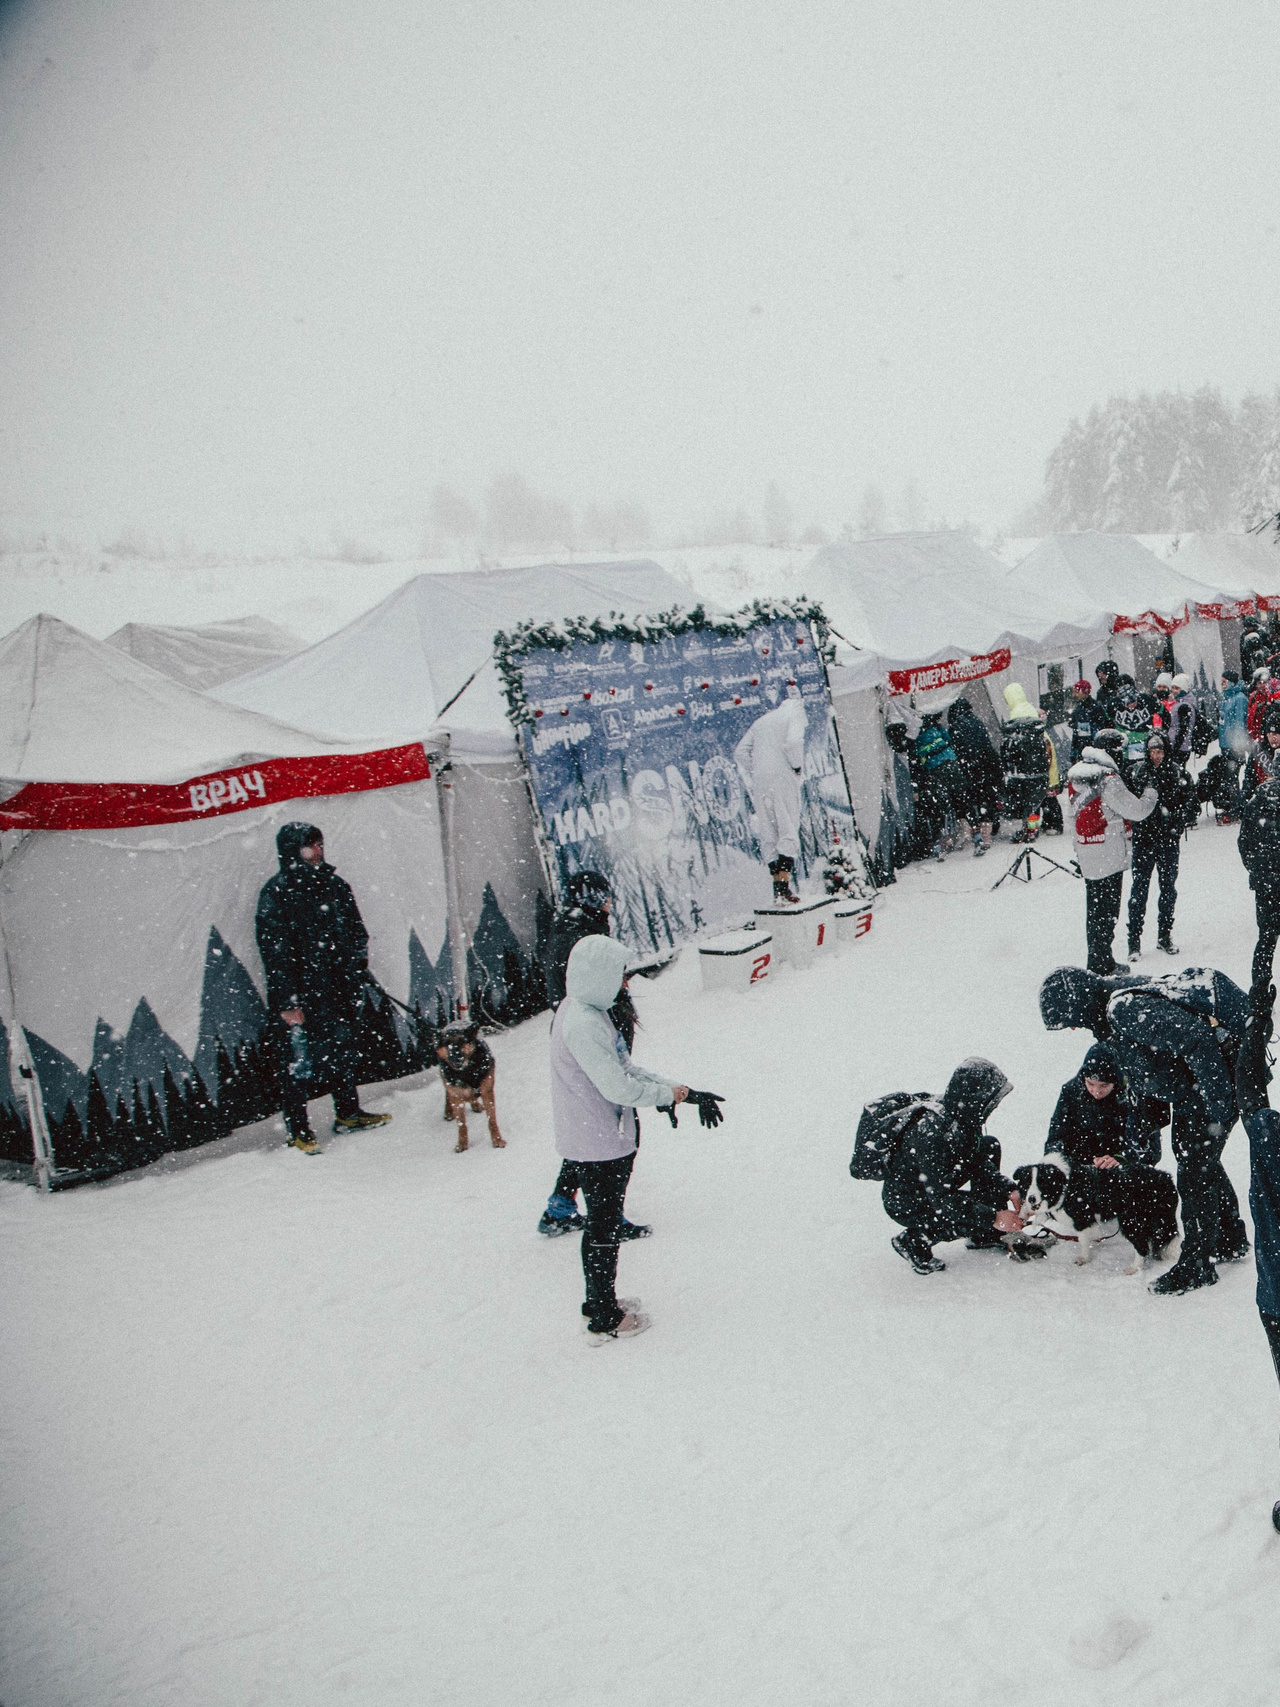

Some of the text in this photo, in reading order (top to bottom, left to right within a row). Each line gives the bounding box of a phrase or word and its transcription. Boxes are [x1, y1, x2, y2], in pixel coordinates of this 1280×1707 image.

[189, 770, 267, 812] ВРАЧ
[554, 799, 631, 845] HARD
[630, 755, 743, 841] SNO
[816, 923, 825, 946] 1
[854, 913, 873, 938] 3
[749, 955, 772, 984] 2
